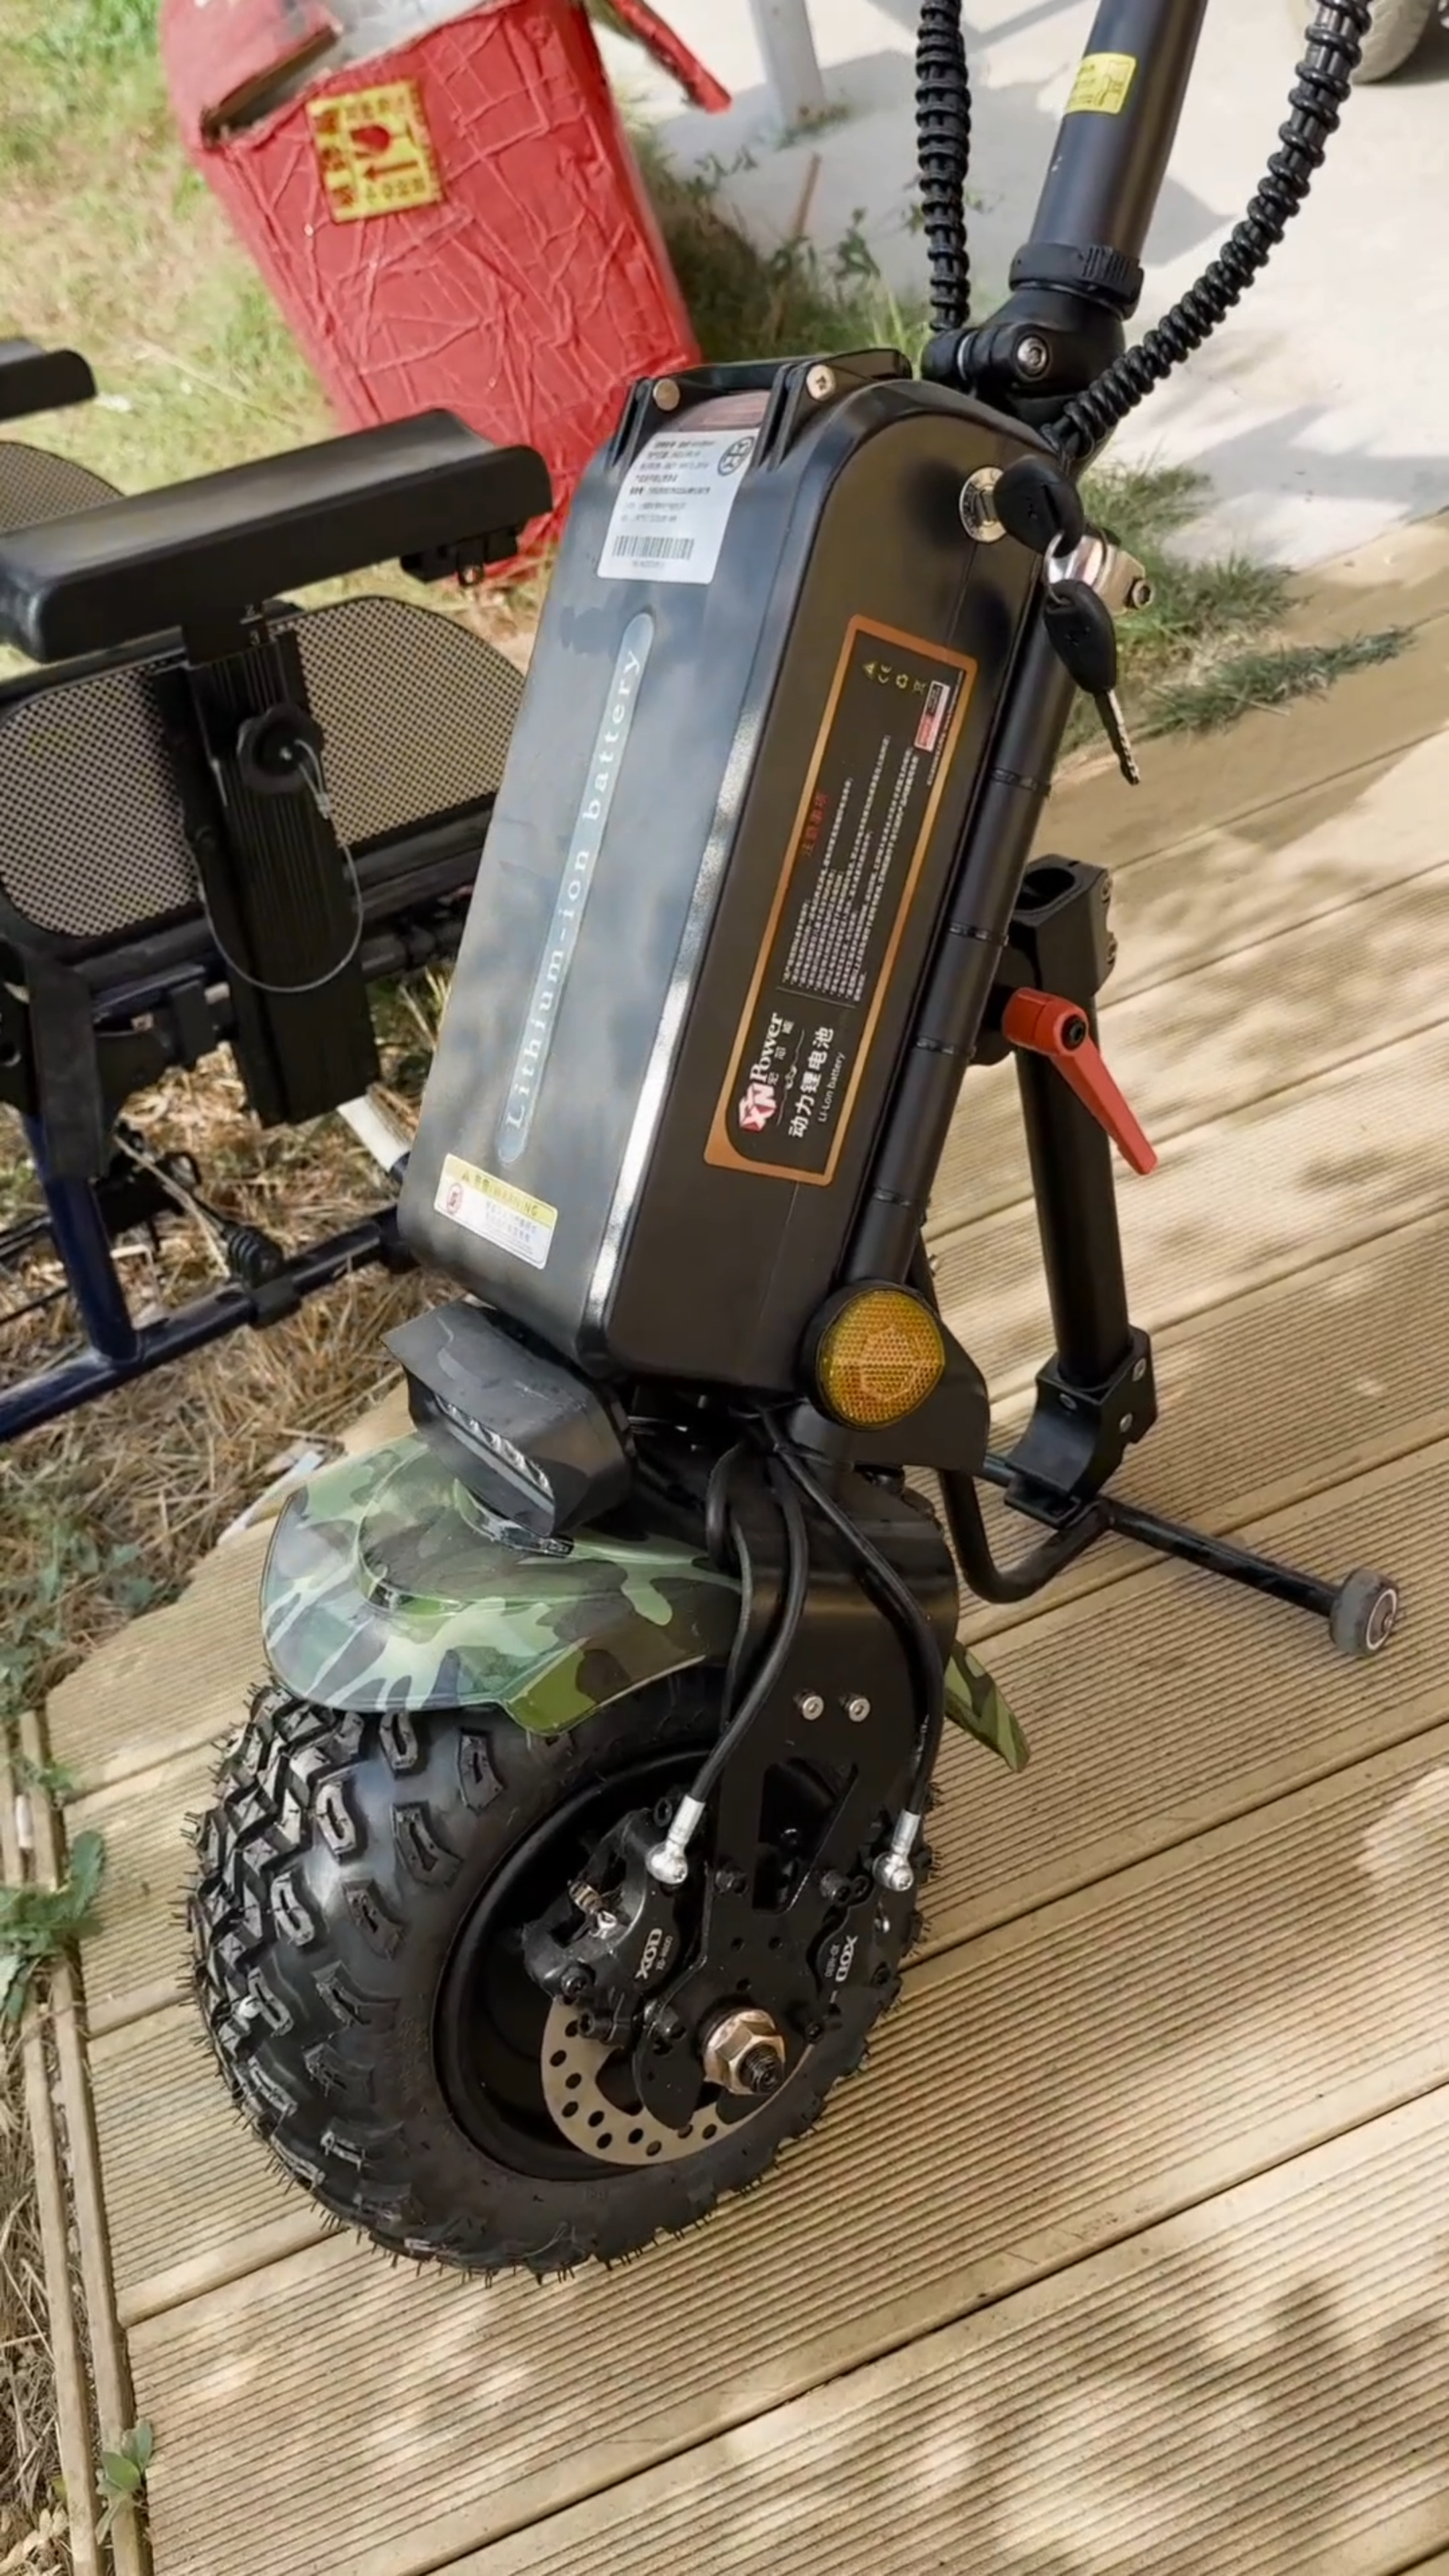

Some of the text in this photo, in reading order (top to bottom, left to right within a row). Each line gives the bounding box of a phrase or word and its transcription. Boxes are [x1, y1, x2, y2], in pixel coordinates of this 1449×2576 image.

[506, 849, 590, 1130] Lithium-ion
[582, 650, 641, 822] battery
[749, 1012, 783, 1083] Power
[826, 1051, 847, 1089] battery
[788, 1026, 834, 1138] 动力锂电池
[634, 1927, 663, 1980] XOD
[835, 1935, 859, 1982] XOD
